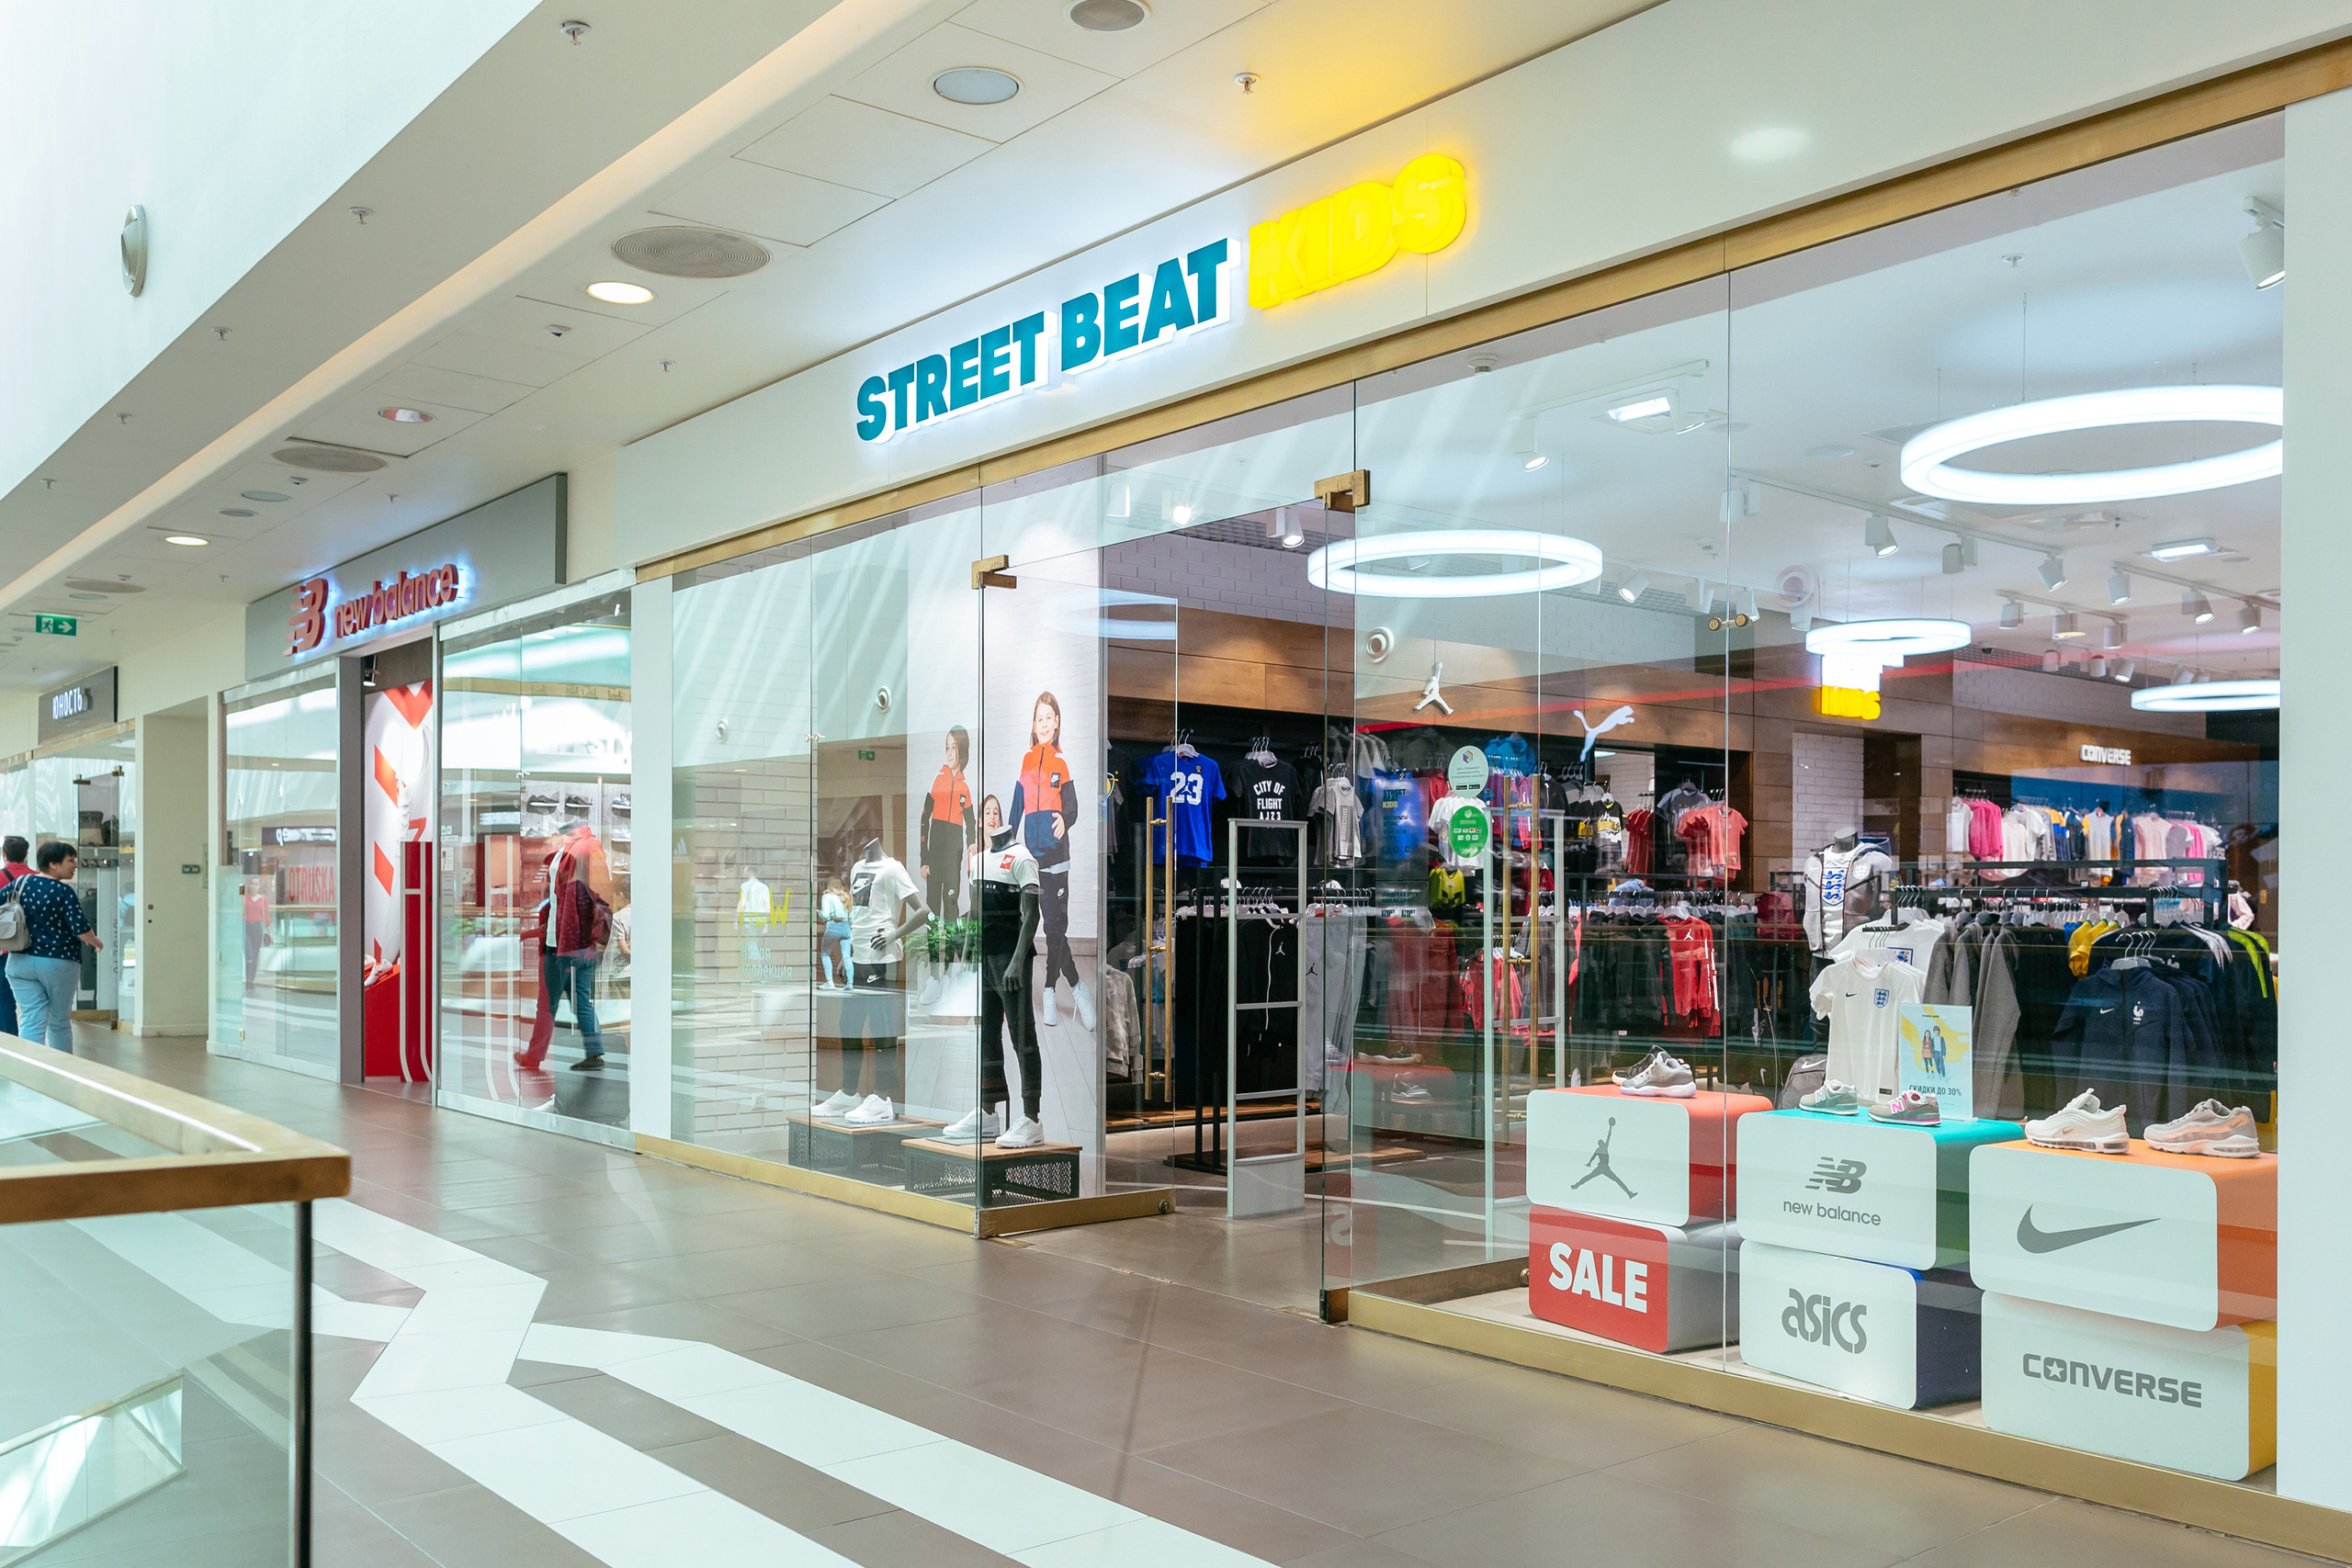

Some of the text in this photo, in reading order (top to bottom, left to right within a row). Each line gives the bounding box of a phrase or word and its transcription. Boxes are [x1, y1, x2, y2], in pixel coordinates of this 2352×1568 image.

[856, 152, 1467, 442] STREET BEAT KIDS
[334, 563, 459, 638] new balance
[52, 686, 83, 720] ЮНОСТЬ
[2079, 744, 2132, 766] CONVERSE
[1170, 771, 1204, 806] 23
[1253, 780, 1286, 795] CITY OF
[1257, 797, 1283, 810] FLIGHT
[1909, 1085, 1962, 1097] СКИДКИ ДО 30%
[1783, 1201, 1882, 1226] new balance
[1549, 1242, 1647, 1314] SALE
[1781, 1288, 1868, 1355] asics
[2023, 1353, 2202, 1408] CONVERSE
